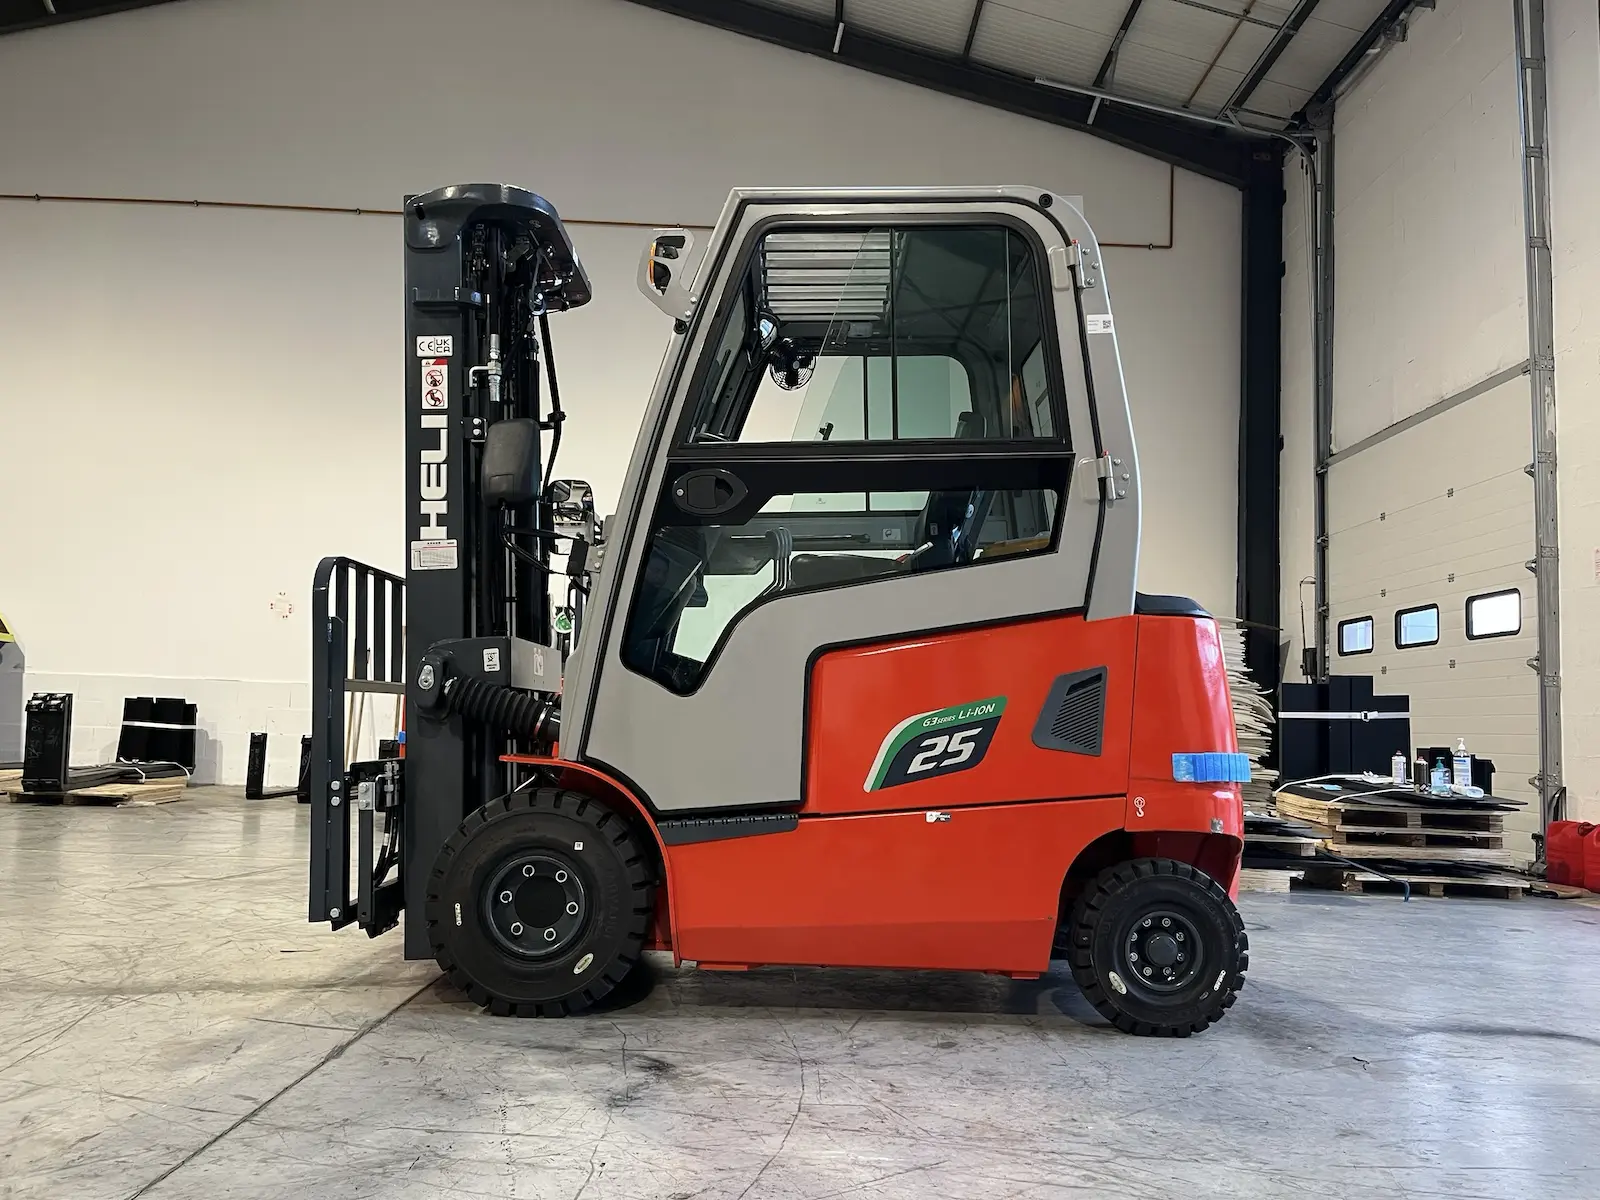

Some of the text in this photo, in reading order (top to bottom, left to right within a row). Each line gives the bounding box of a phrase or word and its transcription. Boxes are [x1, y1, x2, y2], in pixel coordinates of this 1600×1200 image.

[419, 341, 434, 352] CE
[420, 414, 449, 540] HELI
[906, 727, 983, 774] 25
